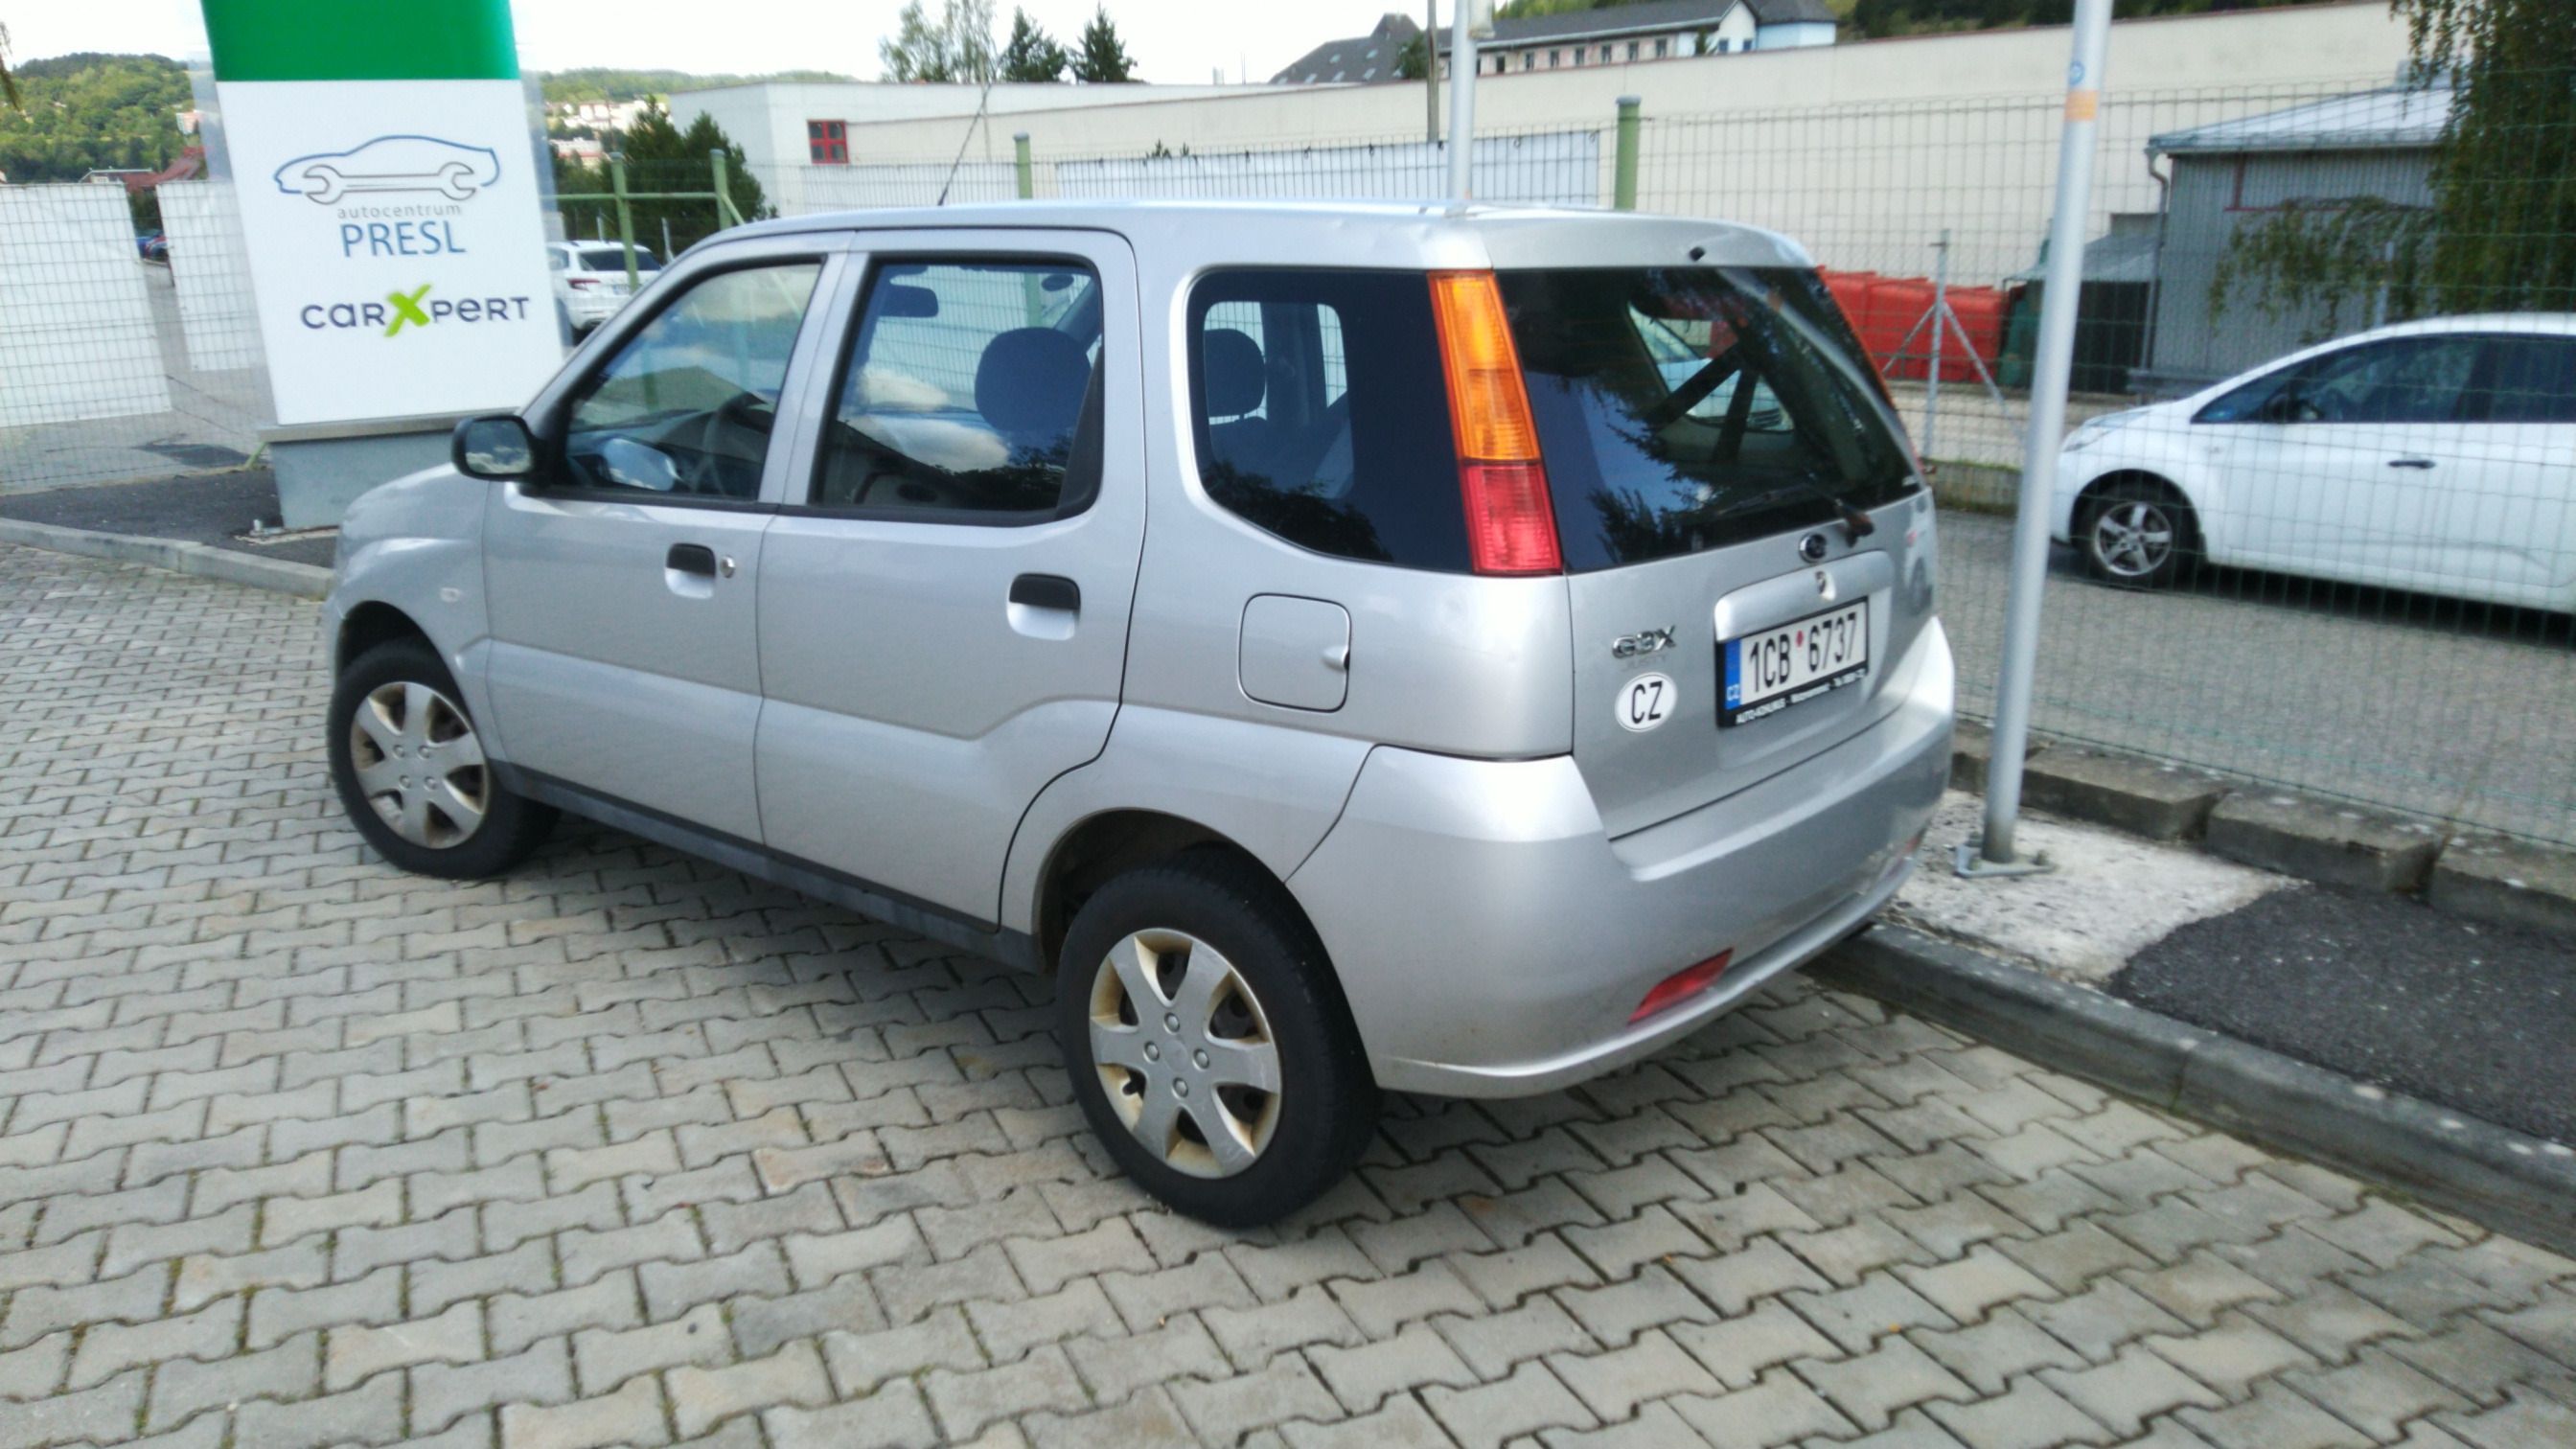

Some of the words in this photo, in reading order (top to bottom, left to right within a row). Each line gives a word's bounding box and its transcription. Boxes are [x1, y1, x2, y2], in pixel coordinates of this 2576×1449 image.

[337, 204, 462, 218] autocentrum
[340, 220, 467, 257] PRESL
[1749, 633, 1791, 693] 1CB
[1808, 611, 1857, 672] 6737
[1631, 680, 1664, 724] CZ
